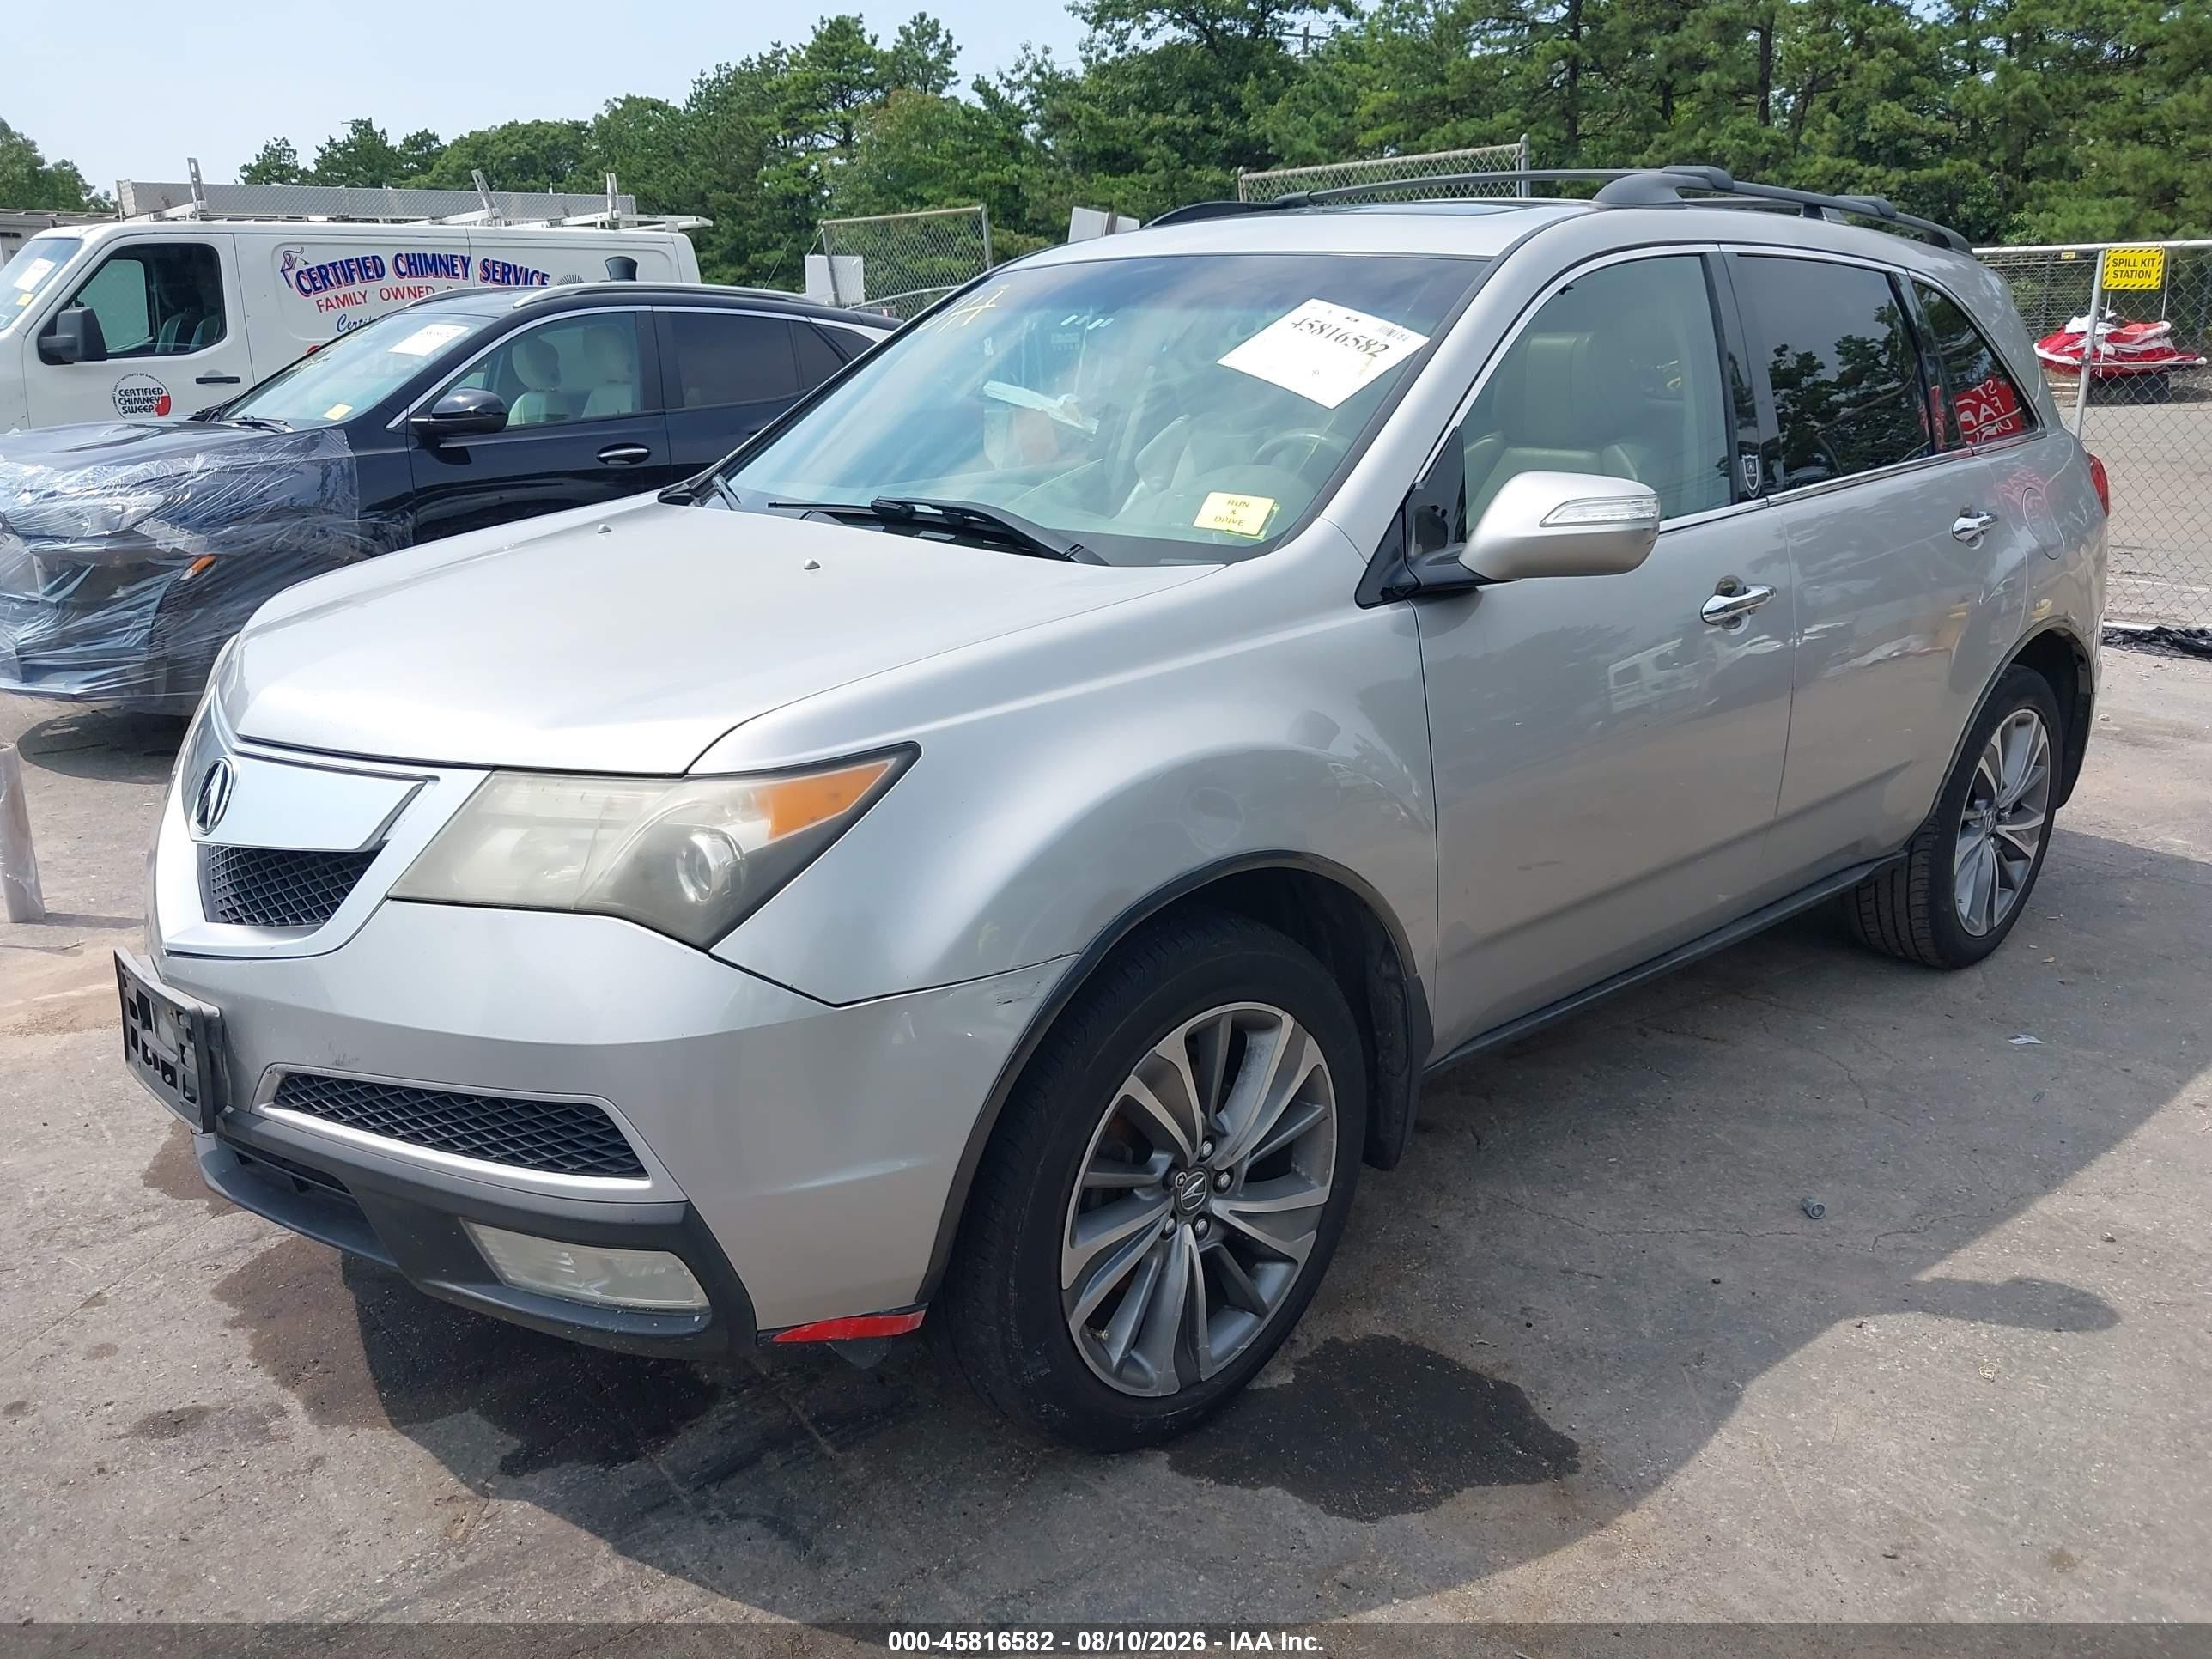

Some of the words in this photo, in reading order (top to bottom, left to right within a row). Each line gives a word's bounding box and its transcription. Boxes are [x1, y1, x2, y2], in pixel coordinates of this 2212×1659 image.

[2112, 258, 2138, 268] SPILL
[2140, 258, 2156, 268] KIT
[295, 254, 386, 297] CERTIFIED
[392, 252, 471, 280] CHIMNEY
[479, 258, 550, 285] SERVICE
[2112, 270, 2152, 279] STATION
[316, 289, 368, 313] FAMILY
[380, 285, 435, 301] OWNED
[1291, 317, 1390, 358] 45816582
[118, 387, 164, 397] CERTIFIED
[118, 396, 161, 405] CHIMNEY
[121, 404, 155, 414] SWEEP
[1226, 499, 1251, 508] RUN
[1213, 515, 1245, 526] DRIVE
